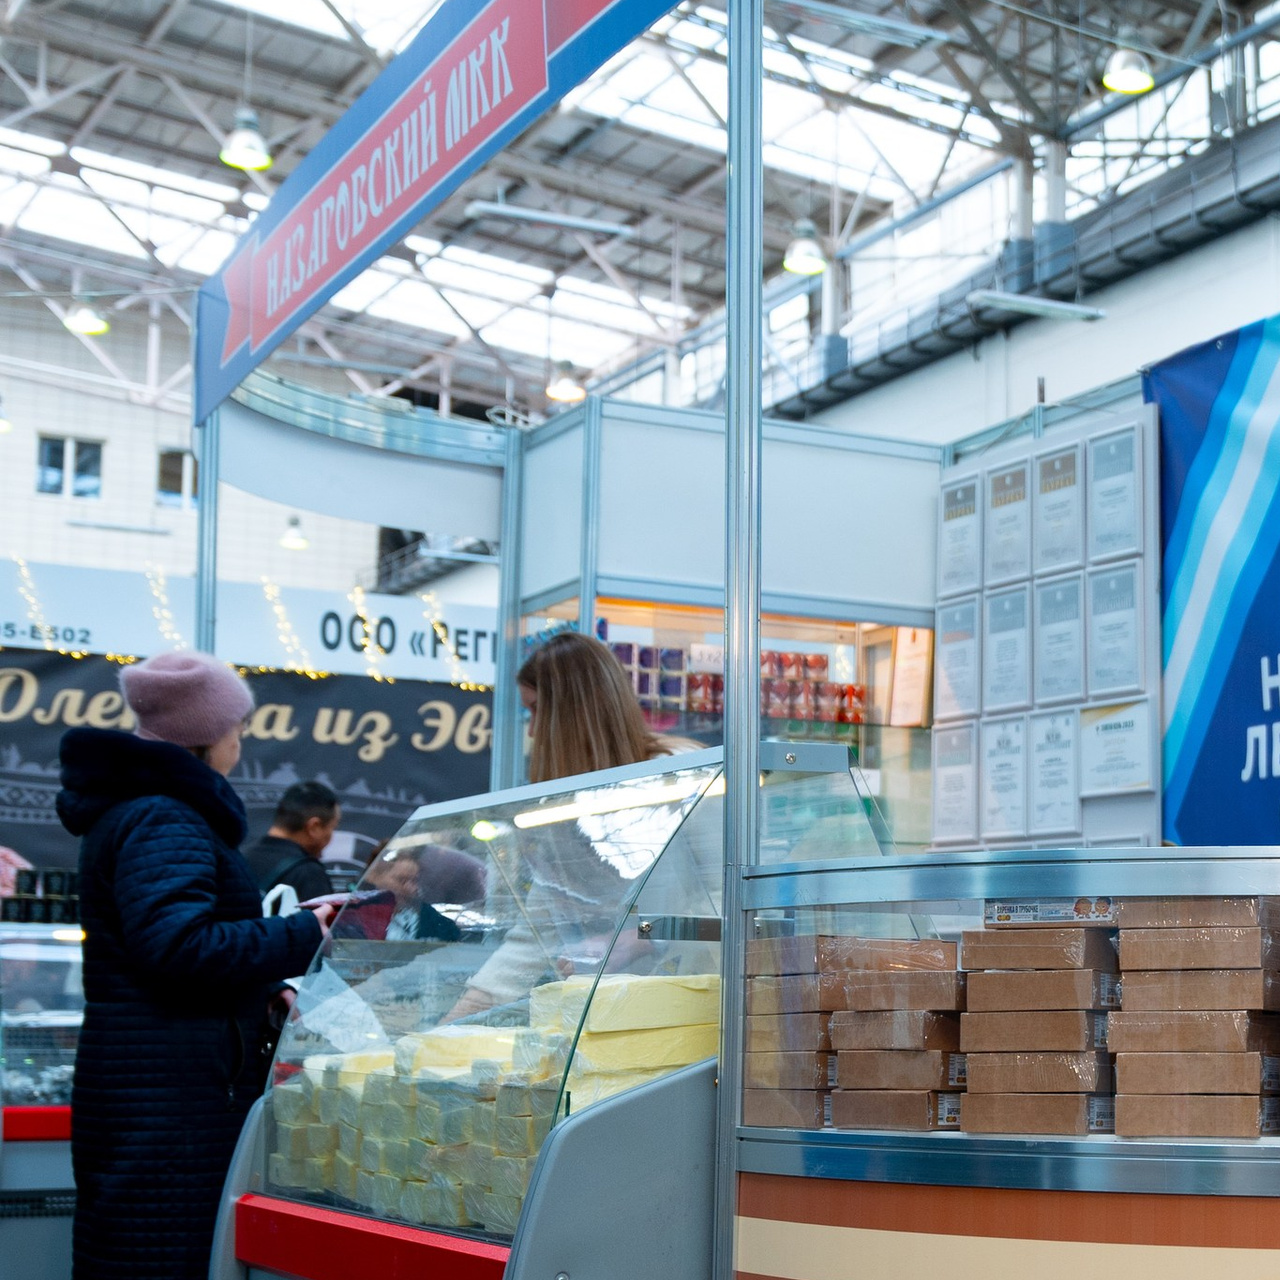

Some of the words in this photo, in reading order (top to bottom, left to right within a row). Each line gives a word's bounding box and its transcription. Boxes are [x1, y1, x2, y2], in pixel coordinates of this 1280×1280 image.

[266, 77, 439, 317] НАЗАРОВСКИЙ
[445, 17, 514, 151] МКК
[320, 611, 396, 656] ООО
[314, 708, 398, 763] из
[411, 700, 492, 753] Эв
